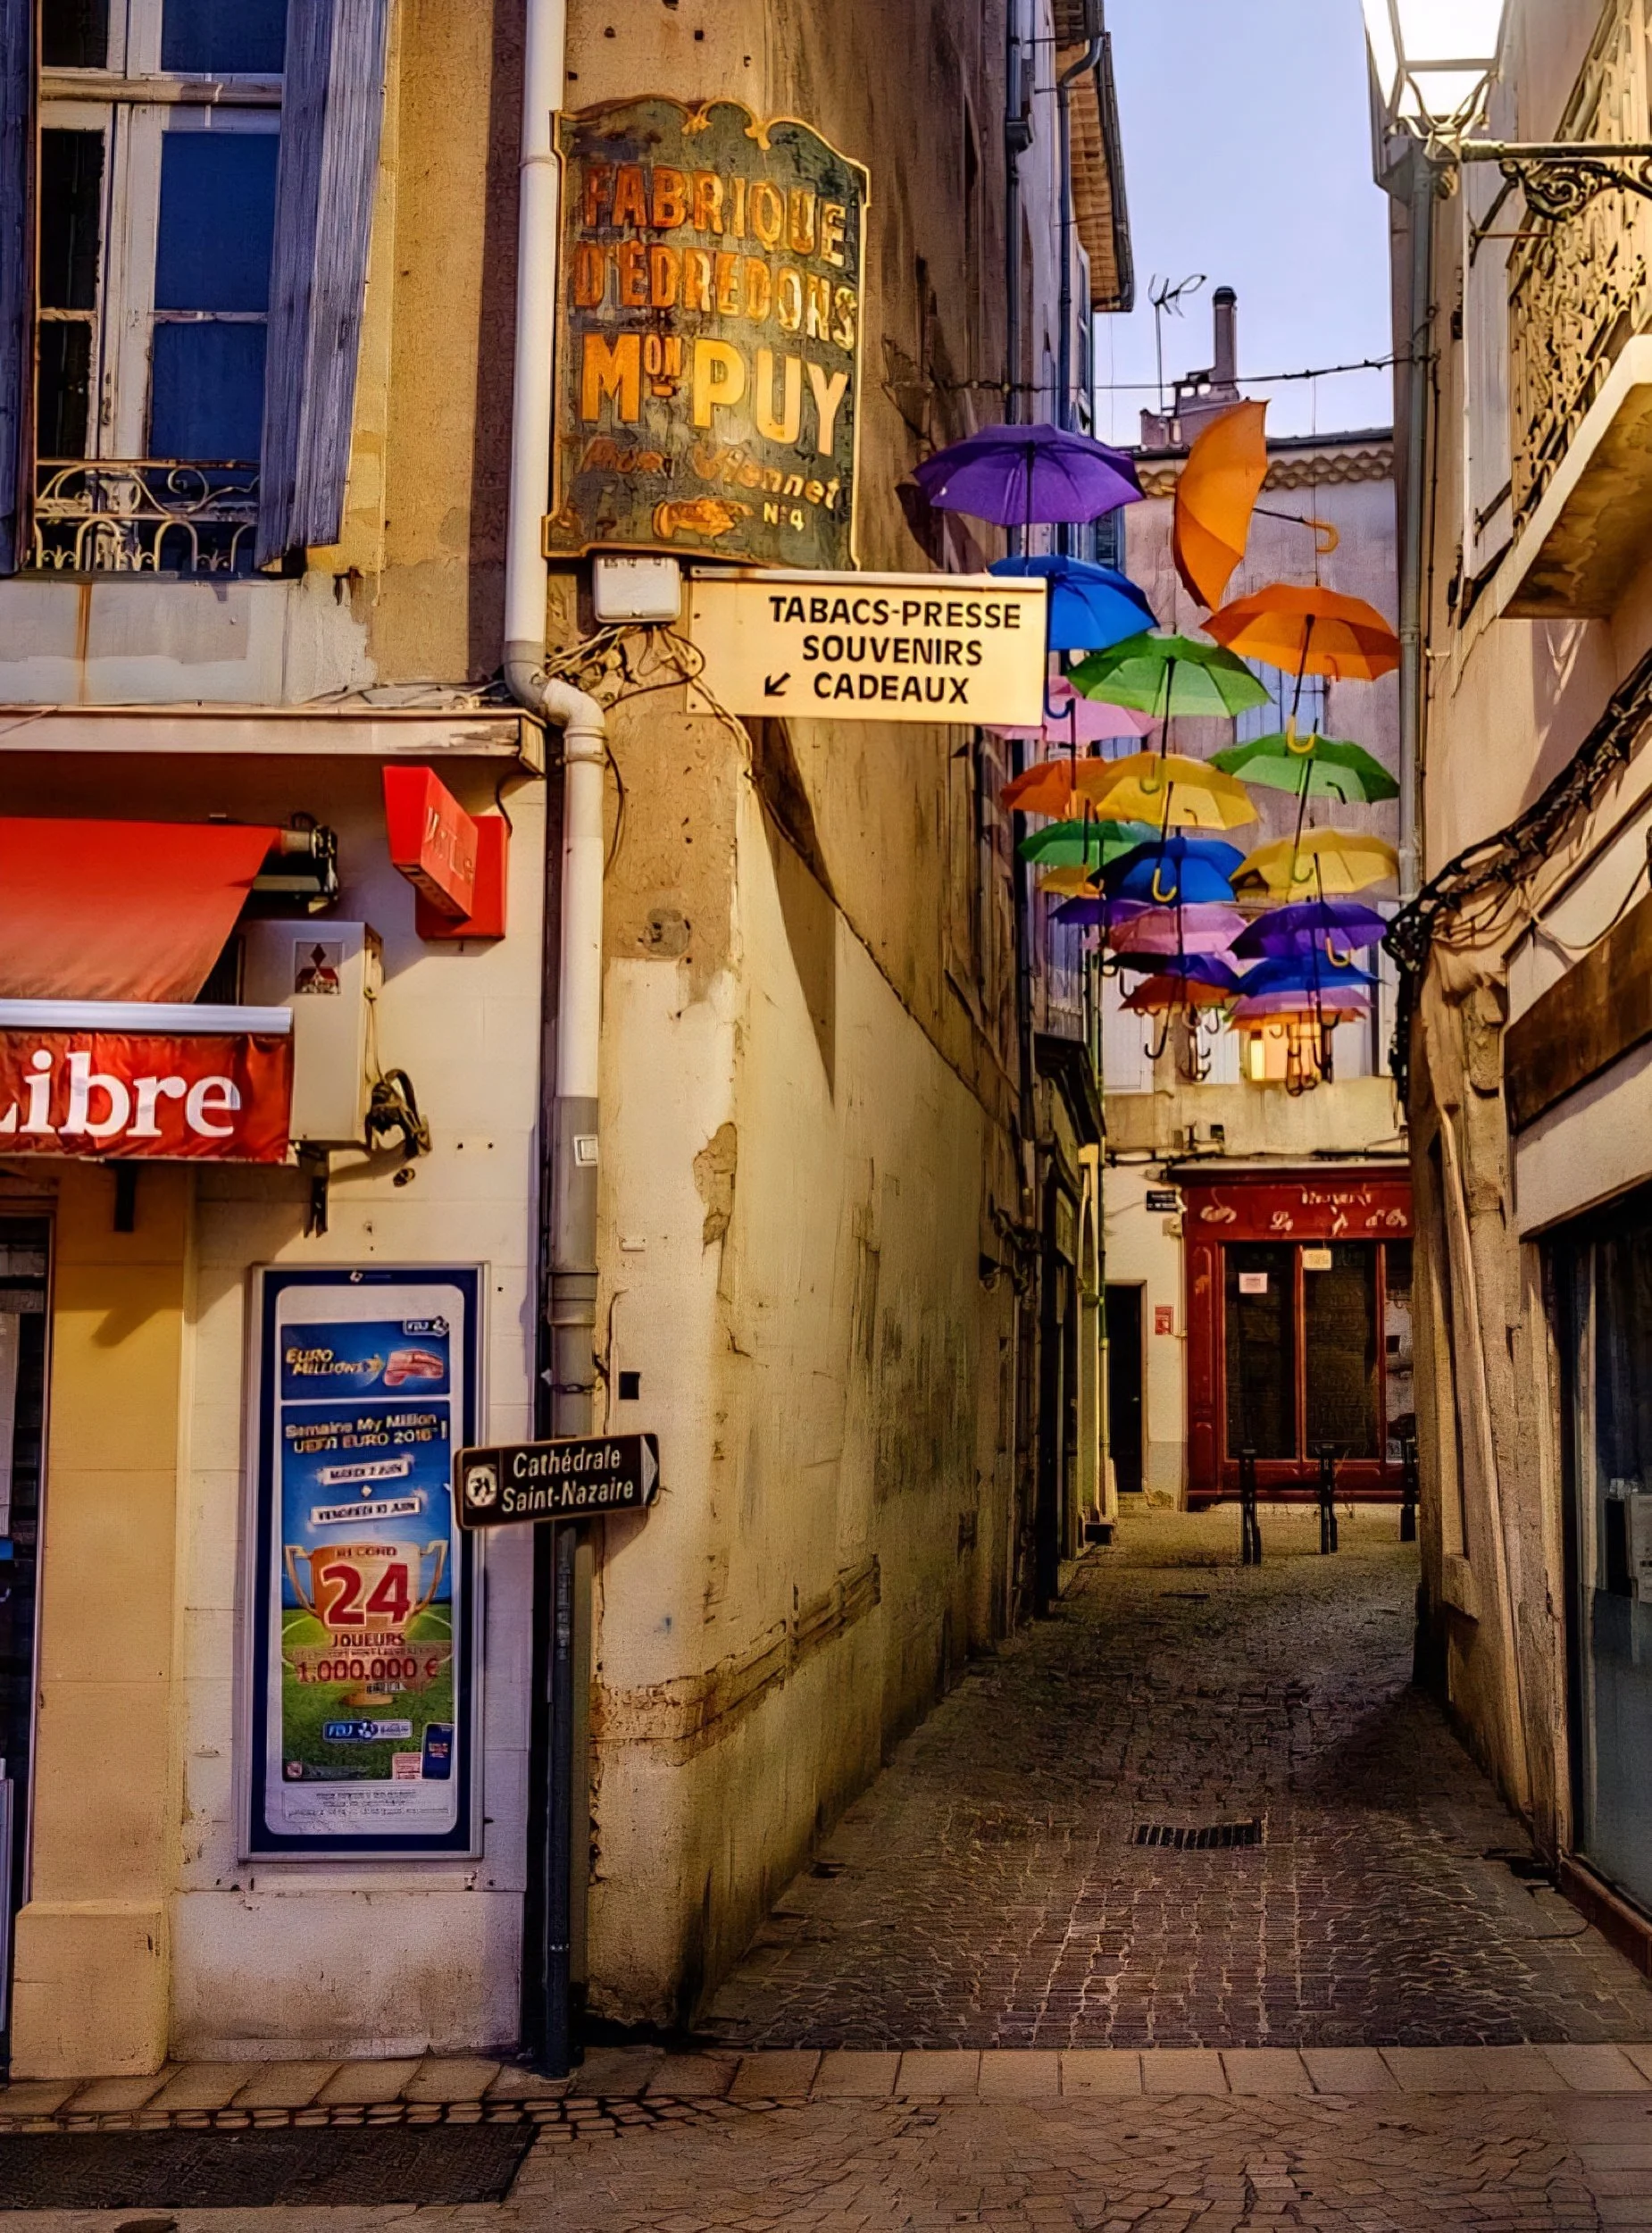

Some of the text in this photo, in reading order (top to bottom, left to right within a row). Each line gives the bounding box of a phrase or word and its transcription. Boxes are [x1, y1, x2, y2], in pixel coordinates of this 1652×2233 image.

[584, 164, 847, 267] FABRIQUE
[693, 338, 849, 456] PUY
[769, 595, 1022, 630] TABACS-PRESSE
[802, 634, 983, 667] SOUVENIRS
[813, 671, 970, 705] CADEAUX
[513, 1443, 622, 1478] Cathédrale
[500, 1476, 634, 1513] Saint-Nazaire
[321, 1562, 412, 1627] 24
